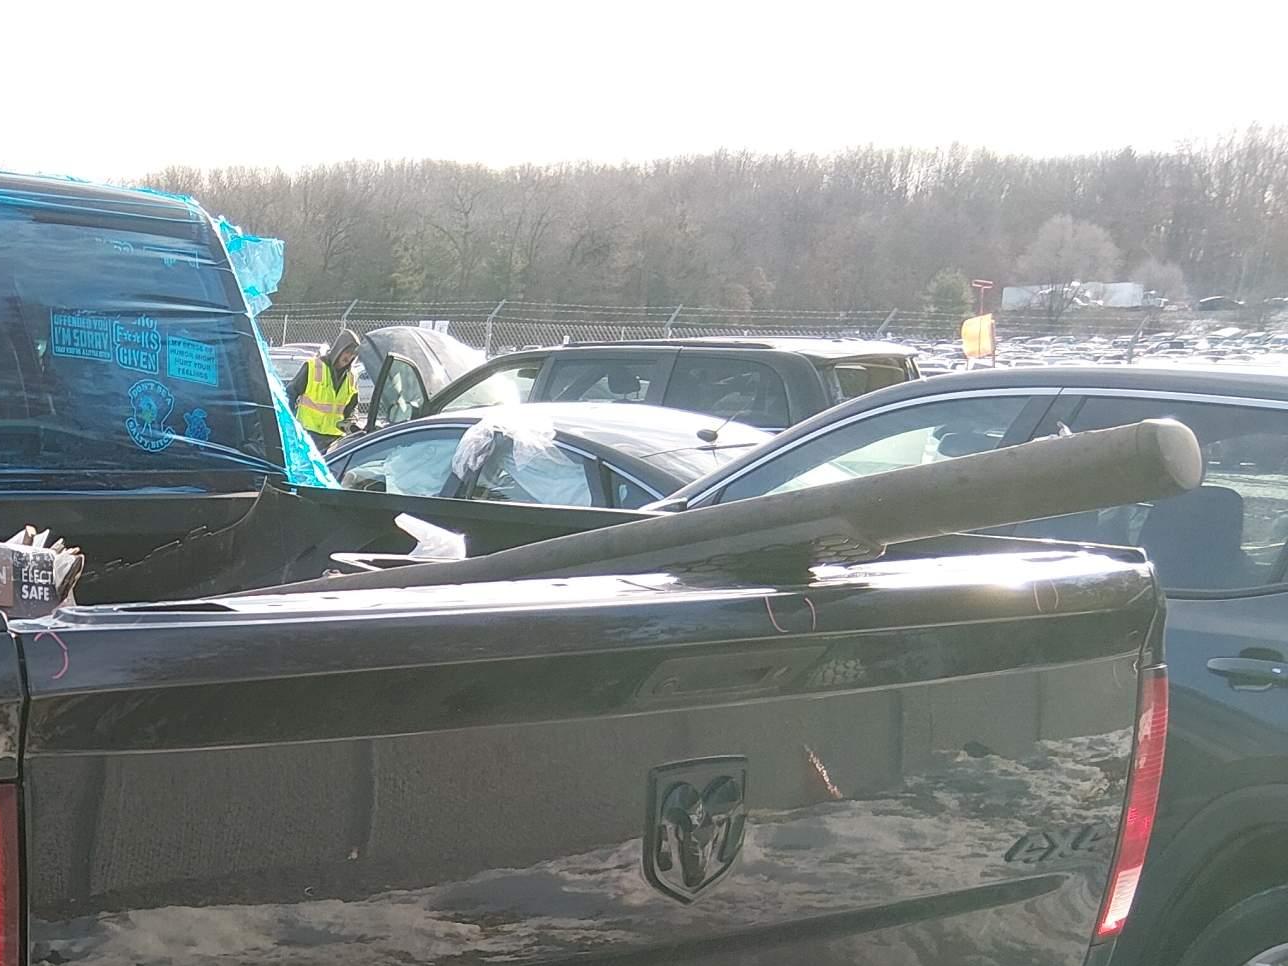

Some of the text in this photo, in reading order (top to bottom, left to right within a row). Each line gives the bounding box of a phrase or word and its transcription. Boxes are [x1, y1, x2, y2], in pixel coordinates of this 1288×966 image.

[93, 318, 108, 331] YOU
[54, 326, 109, 350] I'M SORRY
[119, 346, 157, 371] GIVEN
[21, 585, 50, 602] SAFE
